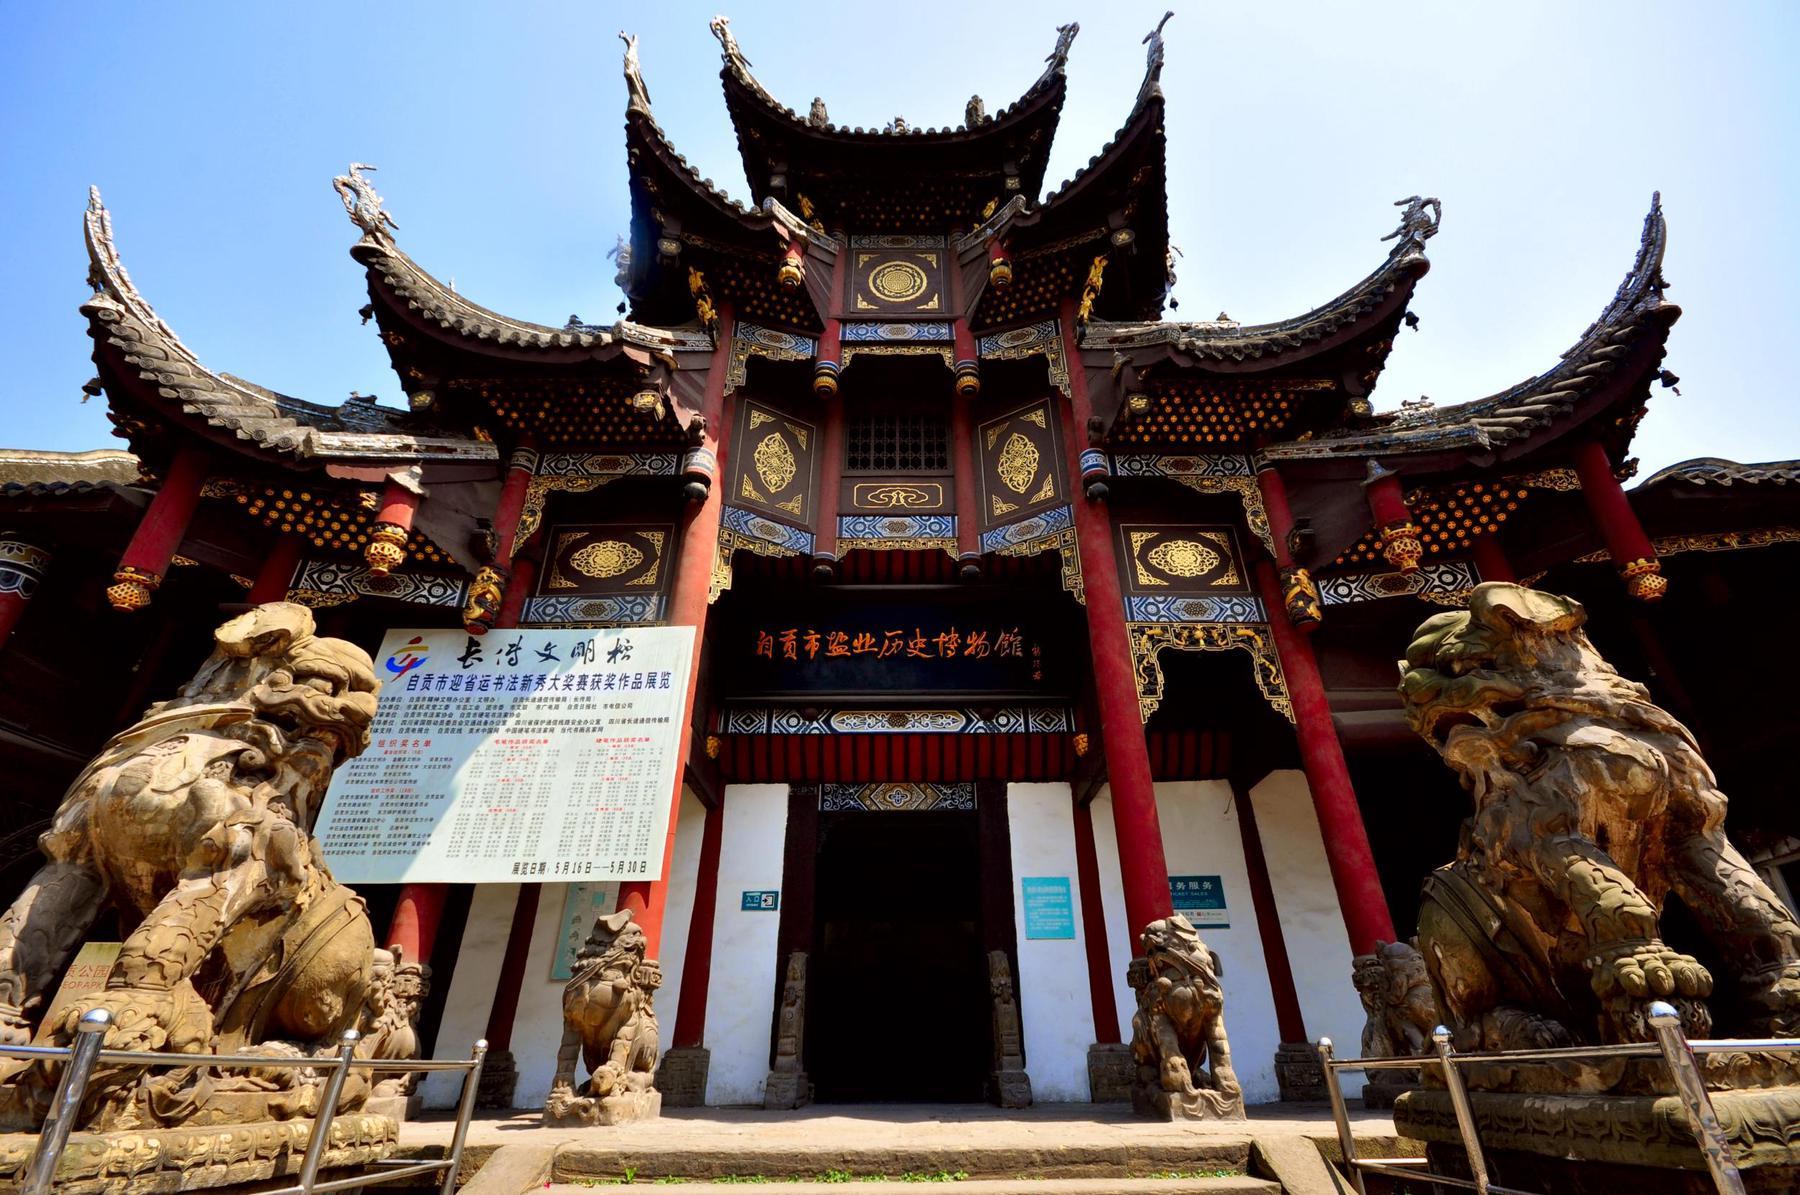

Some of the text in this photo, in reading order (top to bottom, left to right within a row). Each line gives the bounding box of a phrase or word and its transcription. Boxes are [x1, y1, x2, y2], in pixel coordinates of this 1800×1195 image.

[406, 671, 672, 692] 自贡市迎省运书法新秀大奖赛获奖作品展览
